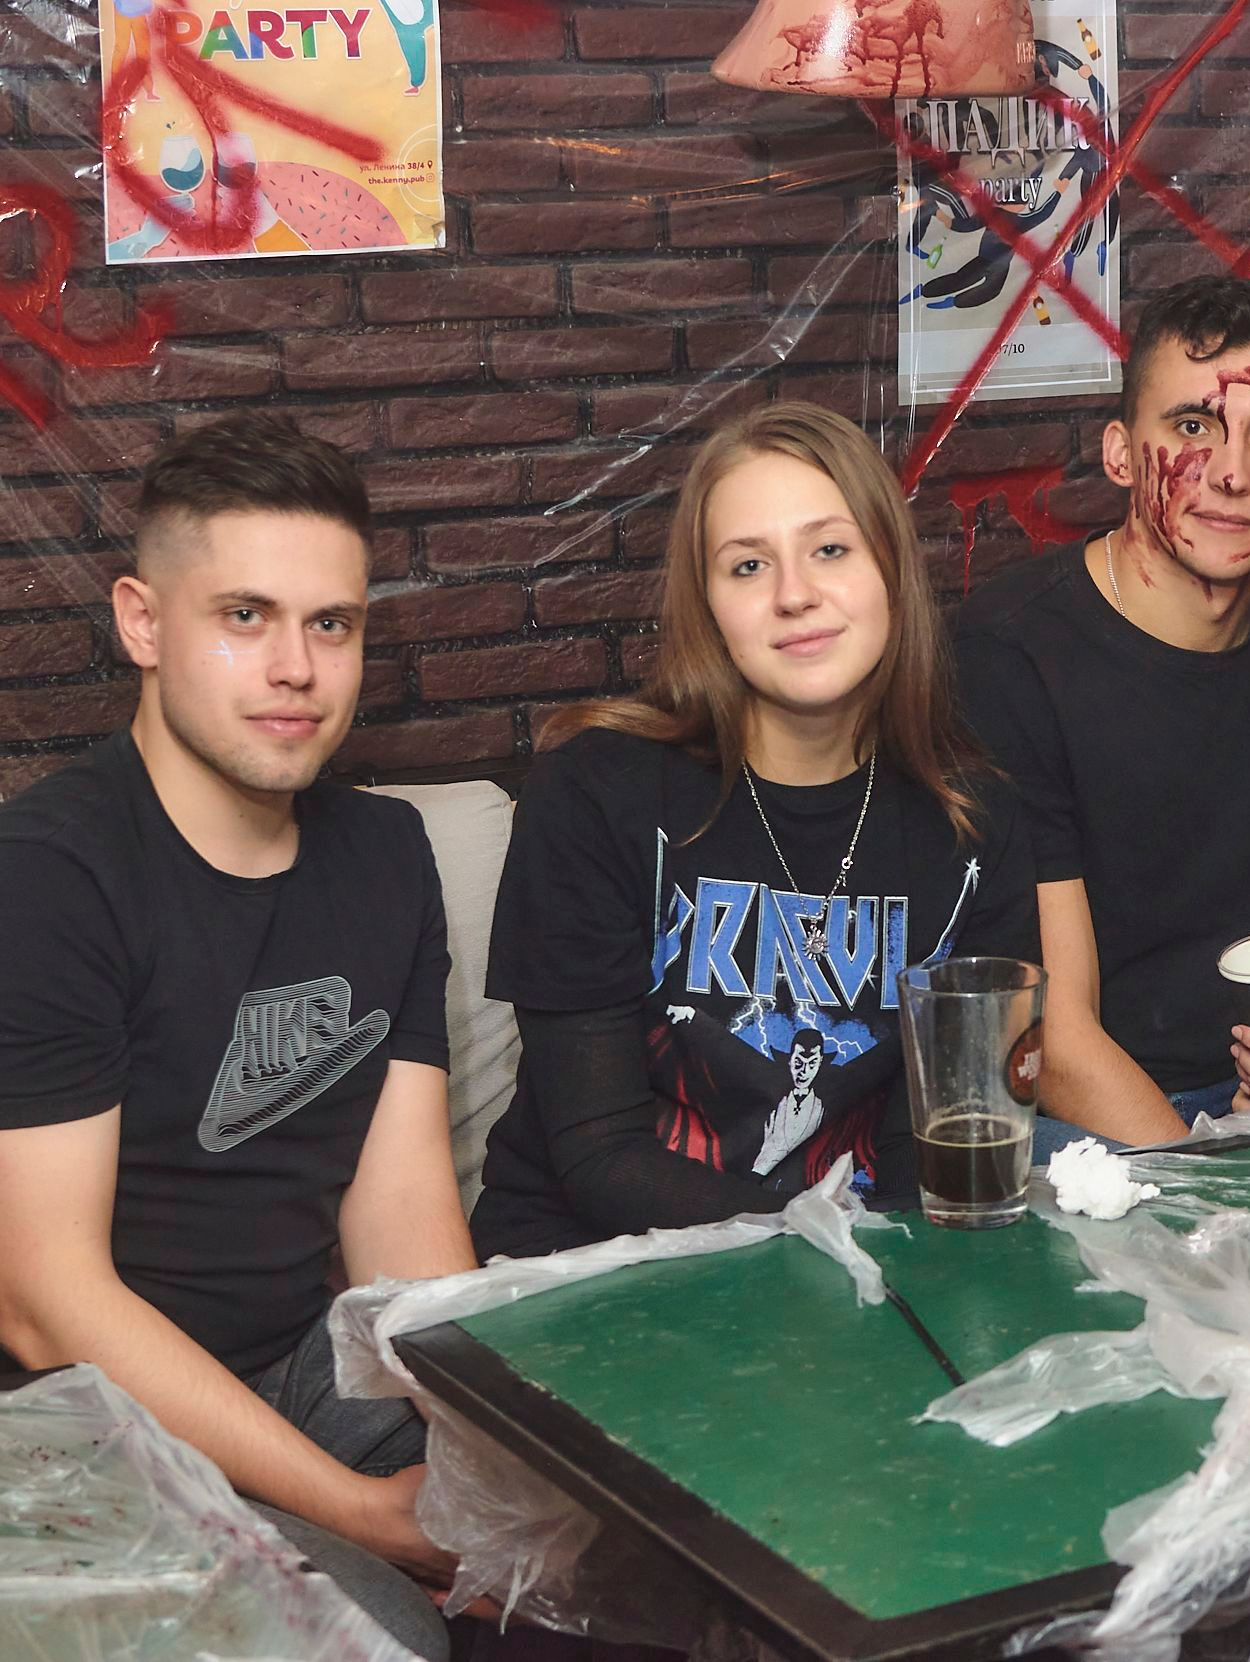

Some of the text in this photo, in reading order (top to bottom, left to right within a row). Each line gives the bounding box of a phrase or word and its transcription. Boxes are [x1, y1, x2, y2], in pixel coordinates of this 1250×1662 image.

[165, 9, 372, 60] PARTY
[407, 161, 425, 171] 38/4
[368, 175, 425, 185] the.kenny.pub
[978, 175, 1043, 209] party
